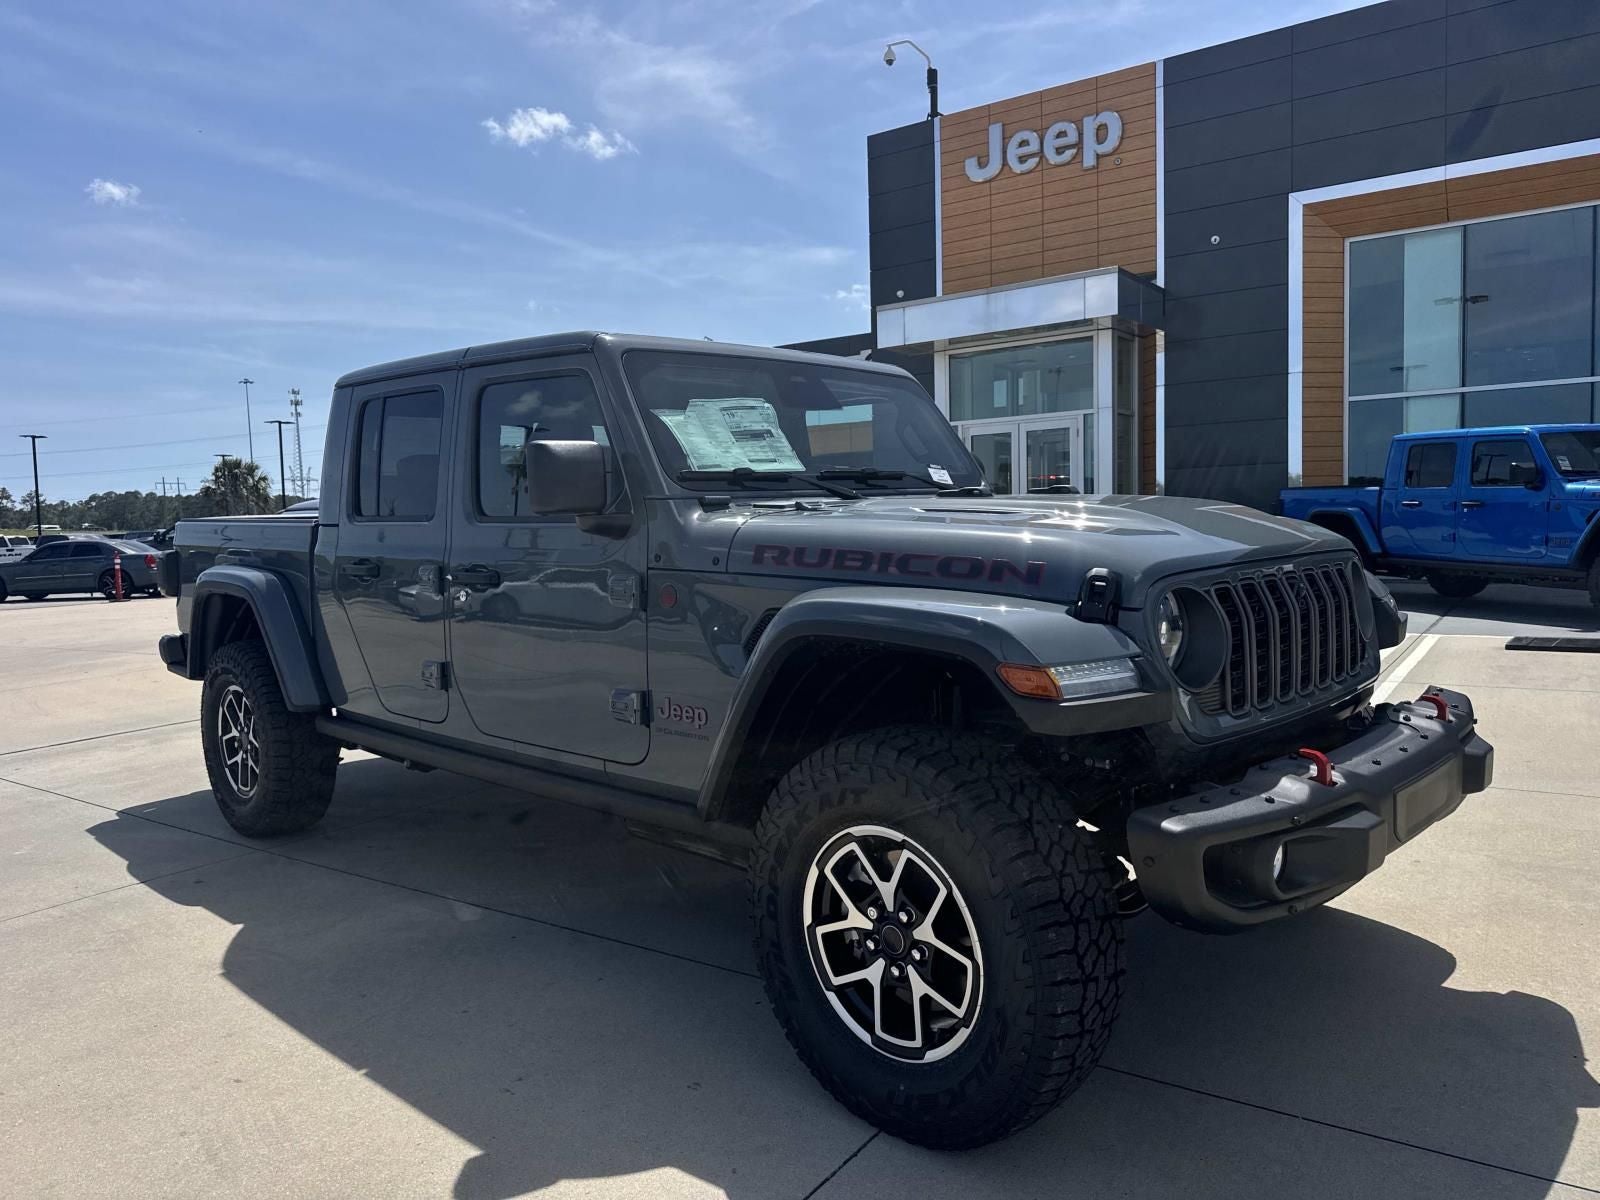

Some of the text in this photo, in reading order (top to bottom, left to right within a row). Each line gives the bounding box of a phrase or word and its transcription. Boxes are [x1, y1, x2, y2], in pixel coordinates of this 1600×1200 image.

[964, 110, 1123, 183] Jeep
[752, 543, 1049, 585] RUBICON
[657, 696, 709, 729] Jeep
